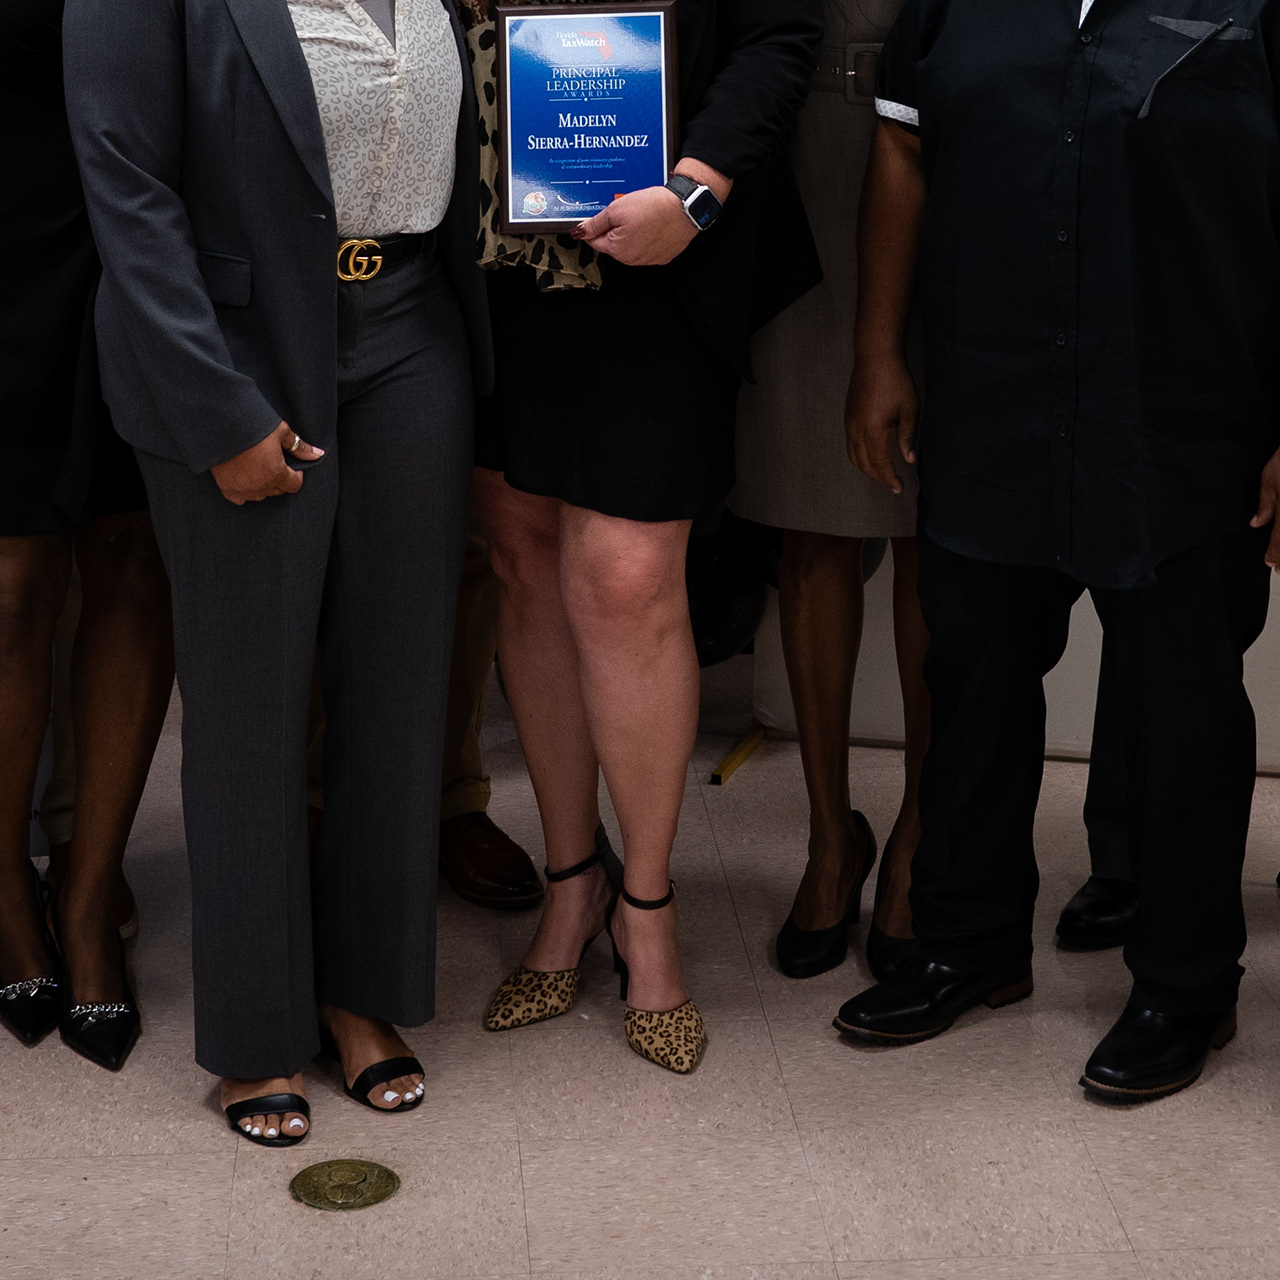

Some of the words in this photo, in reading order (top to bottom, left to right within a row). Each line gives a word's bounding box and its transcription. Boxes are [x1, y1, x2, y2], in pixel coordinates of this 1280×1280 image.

[556, 31, 578, 39] Florida
[561, 37, 606, 48] TaxWatch
[552, 66, 620, 79] PRINCIPAL
[546, 79, 626, 92] LEADERSHIP
[563, 90, 610, 98] AWARDS
